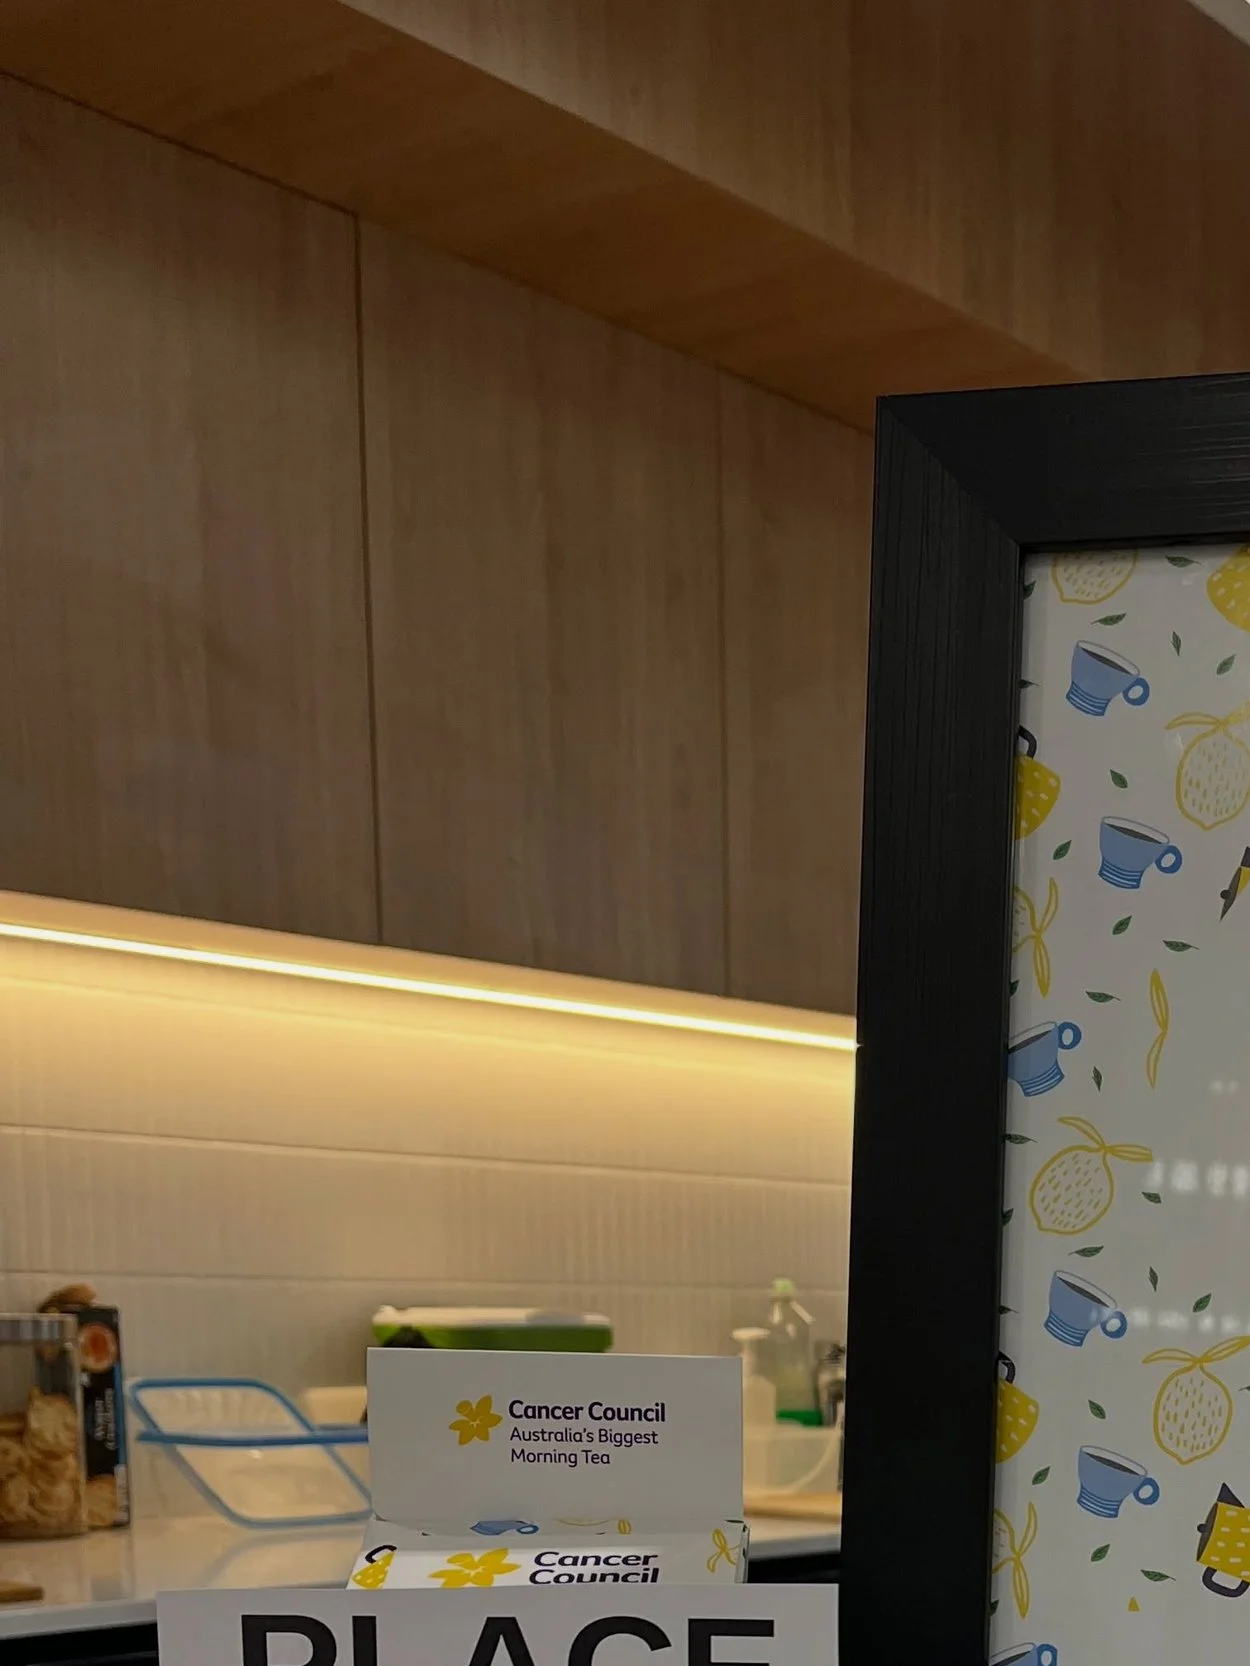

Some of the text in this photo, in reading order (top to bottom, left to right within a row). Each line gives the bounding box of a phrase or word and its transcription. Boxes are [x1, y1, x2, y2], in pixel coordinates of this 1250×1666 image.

[508, 1399, 666, 1422] Cancer Council
[510, 1427, 659, 1447] Australia's Biggest
[511, 1448, 610, 1468] Morning Tea
[534, 1552, 659, 1567] Cancer
[529, 1568, 660, 1585] Council
